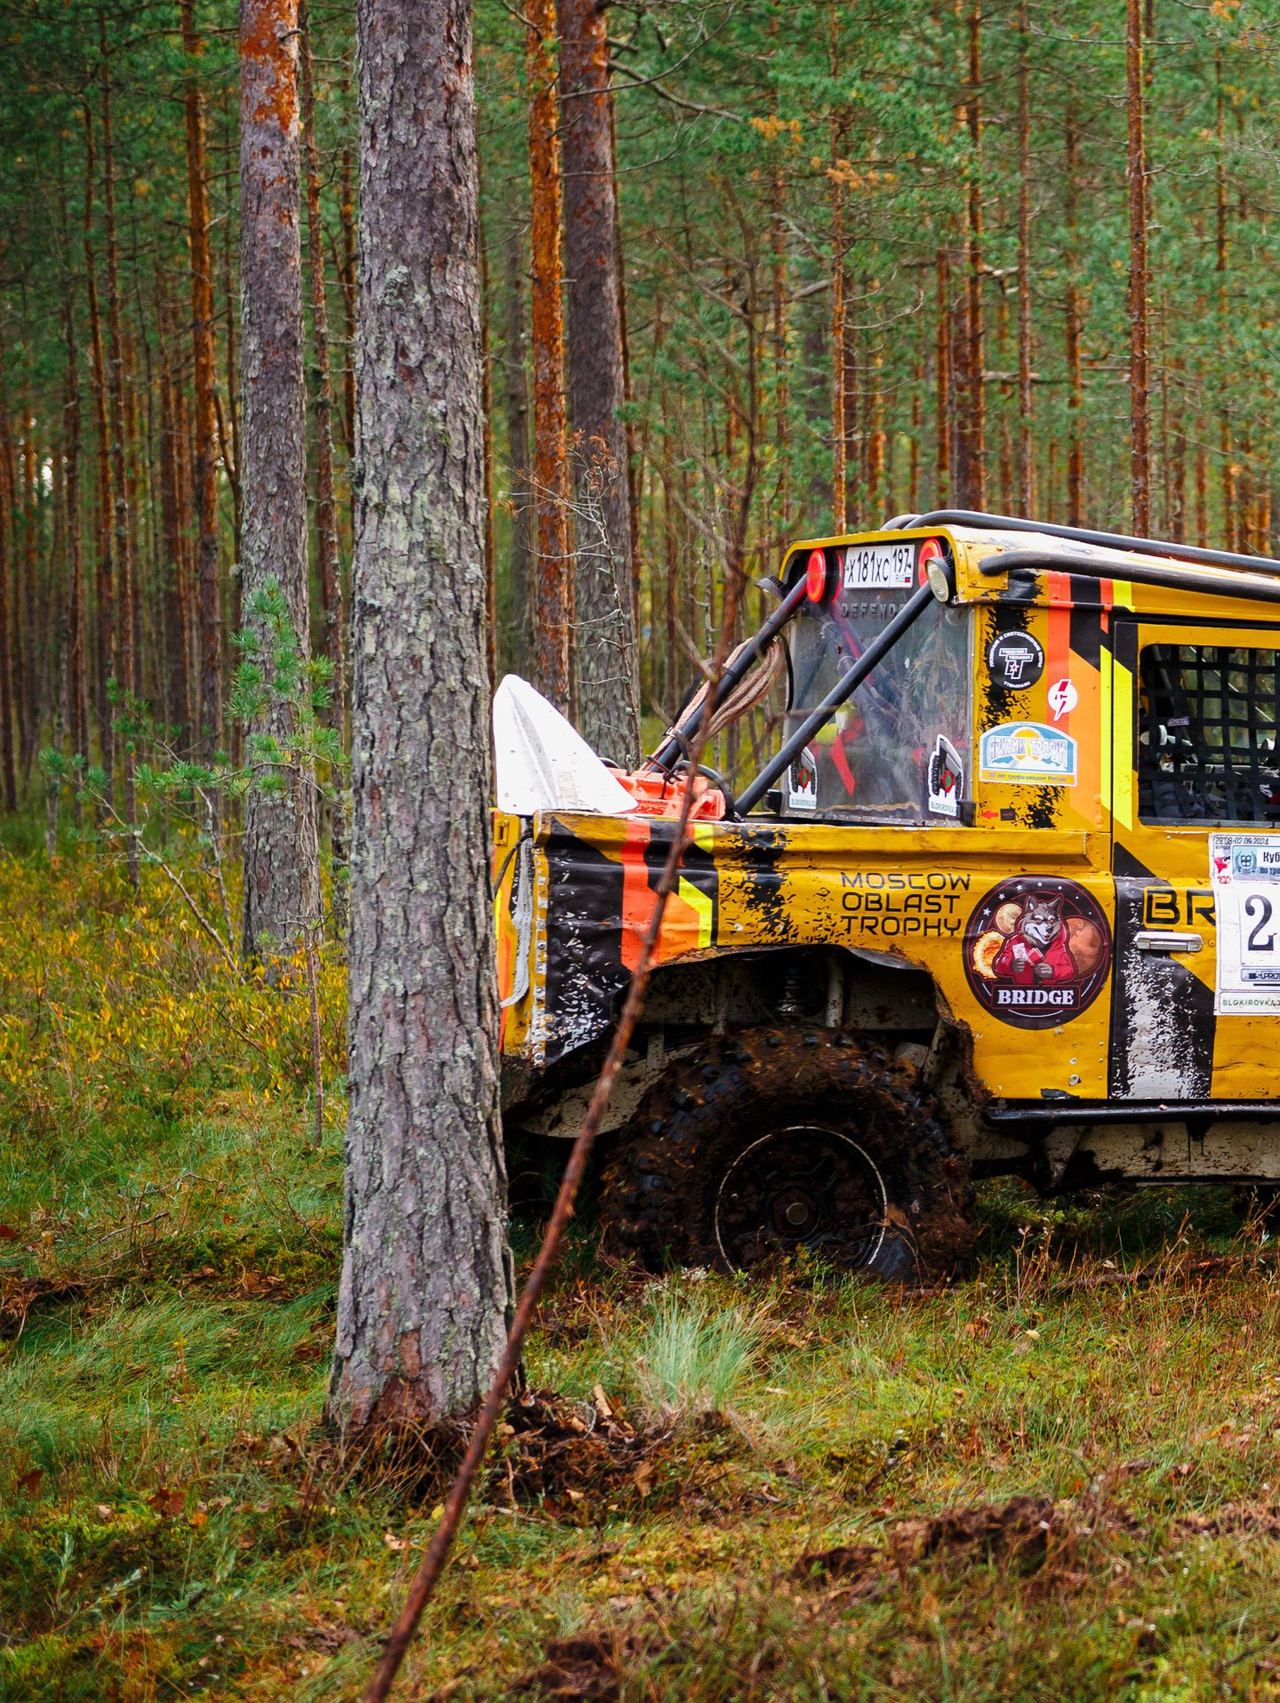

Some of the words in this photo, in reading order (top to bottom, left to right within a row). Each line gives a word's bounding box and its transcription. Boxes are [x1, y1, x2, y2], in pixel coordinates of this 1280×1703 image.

[892, 548, 909, 573] 197
[841, 603, 907, 619] DEFEND
[841, 871, 970, 891] MOSCOW
[842, 892, 961, 914] OBLAST
[841, 915, 962, 937] TROPHY
[997, 989, 1074, 1005] BRIDGE
